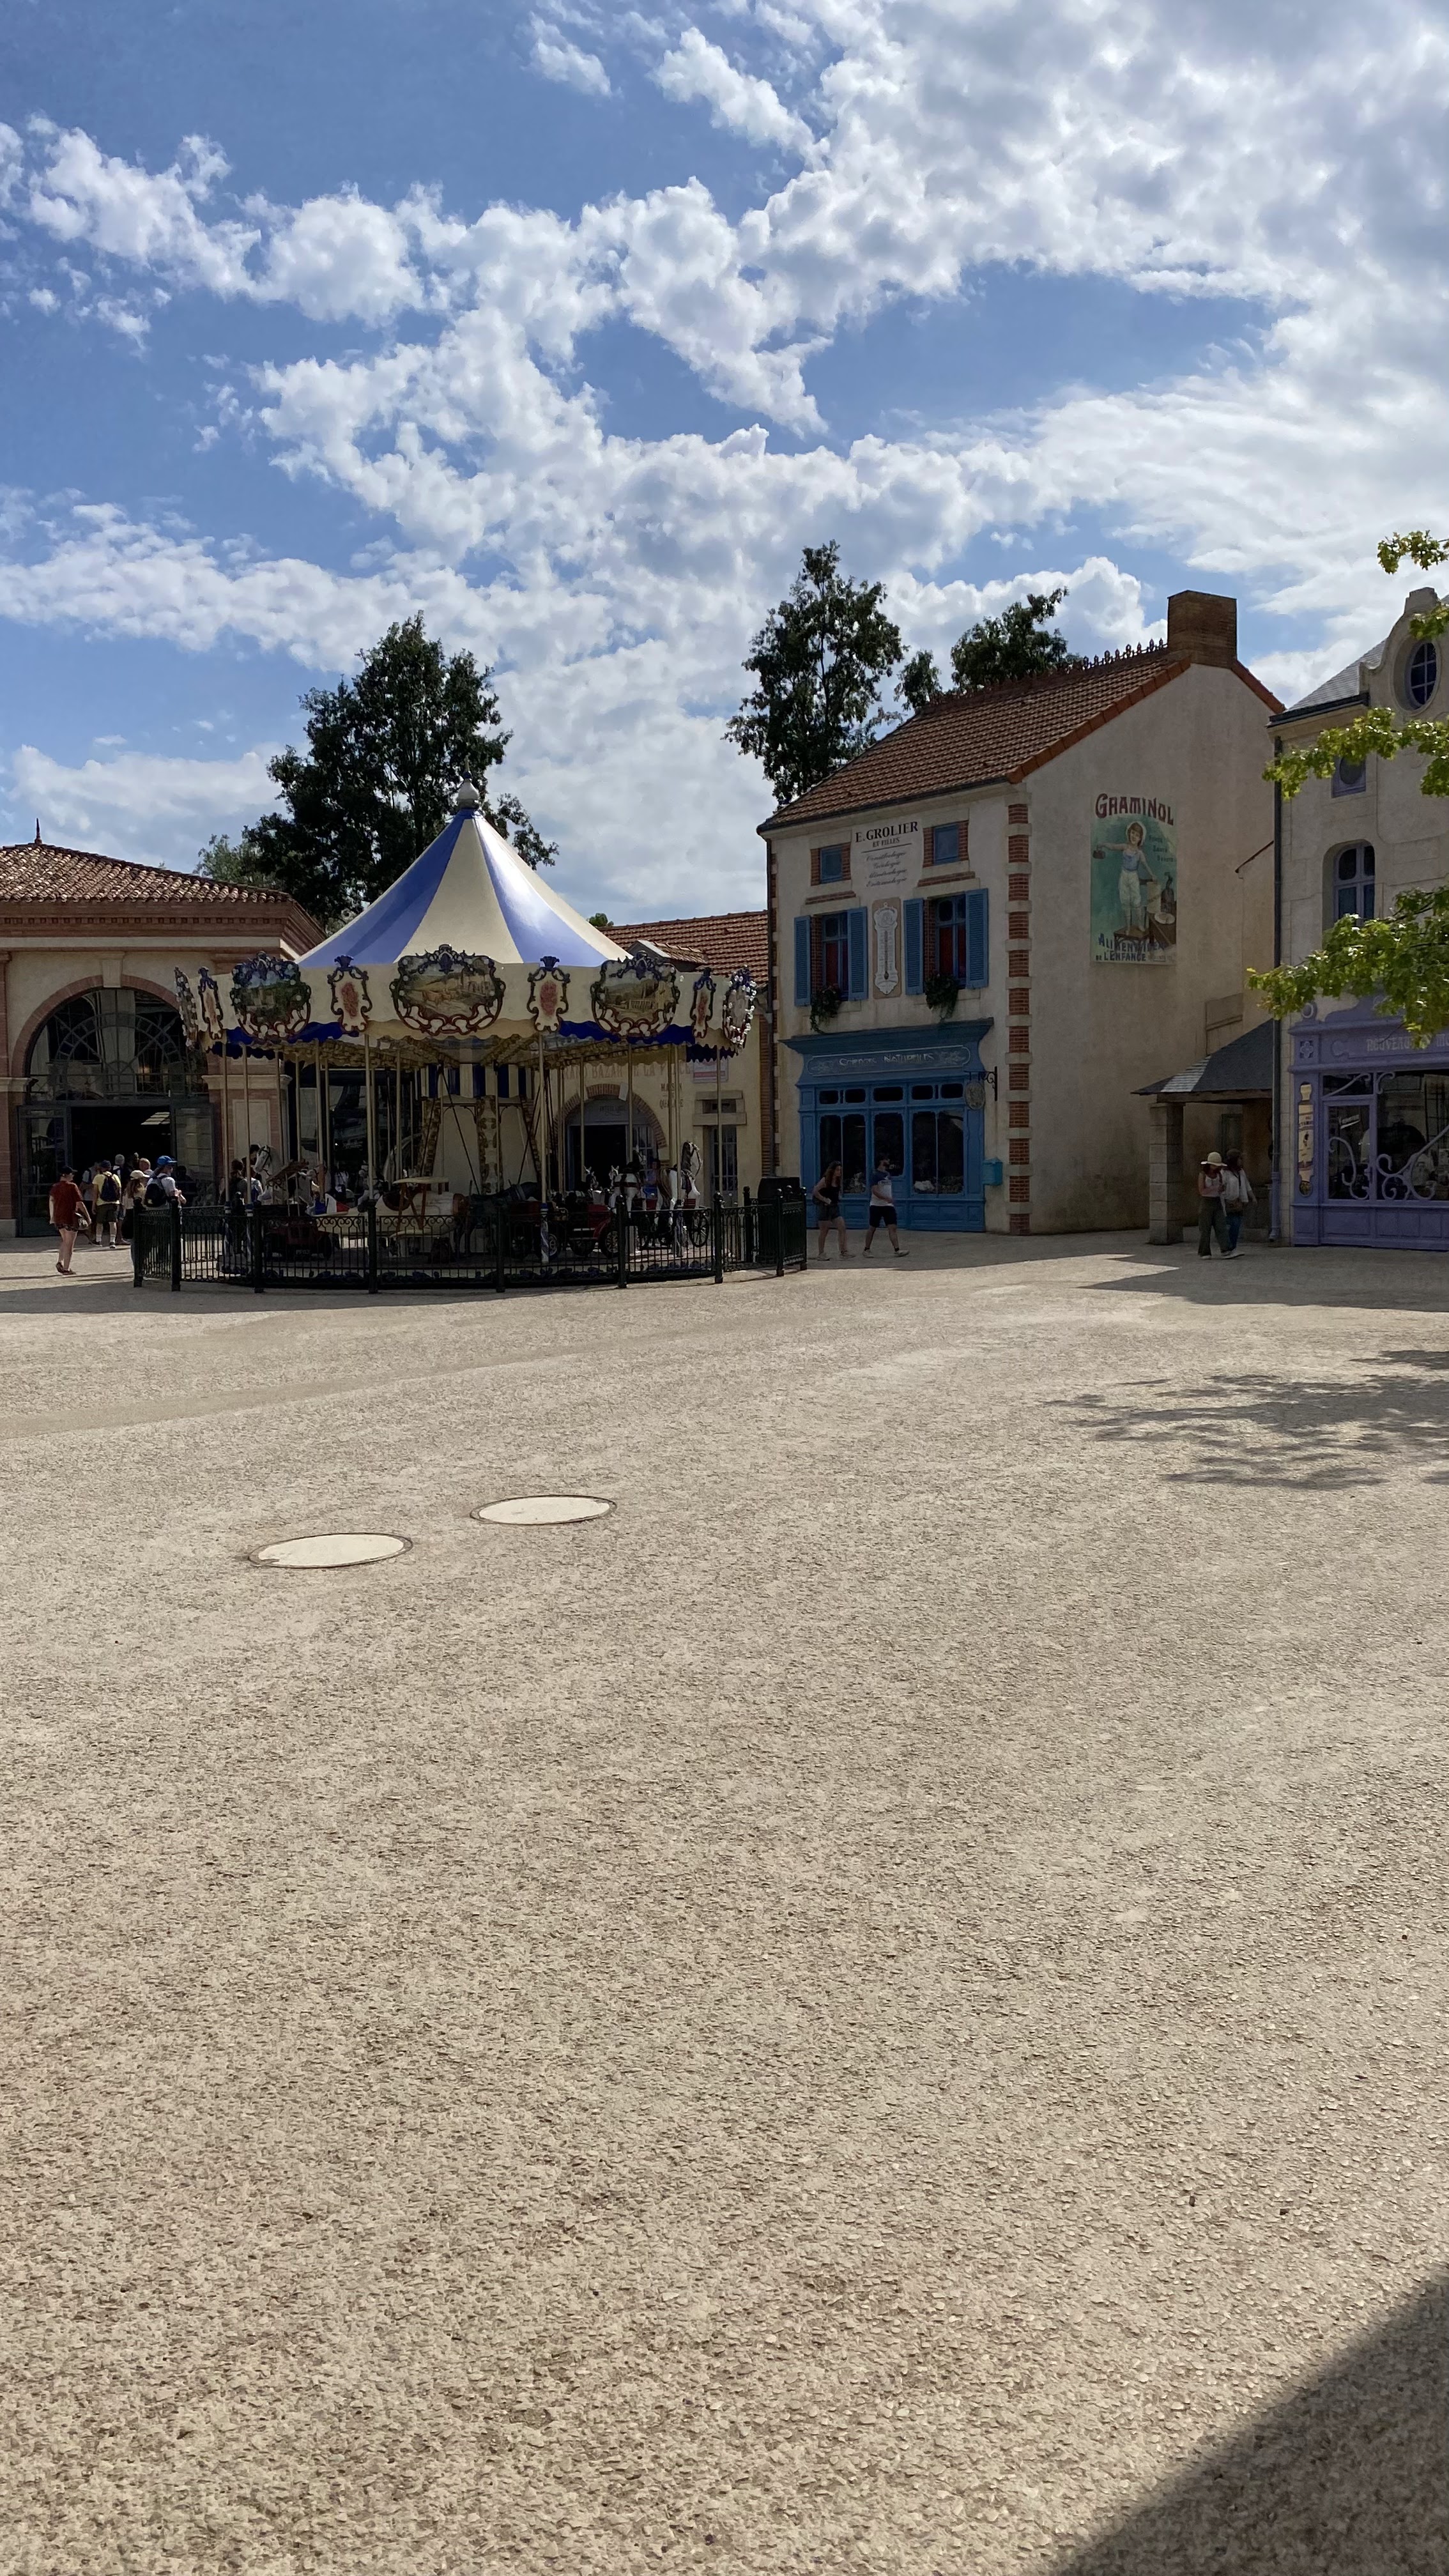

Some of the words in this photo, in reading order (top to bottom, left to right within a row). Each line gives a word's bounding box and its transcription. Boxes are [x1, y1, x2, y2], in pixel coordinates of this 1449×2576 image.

[866, 822, 918, 841] GROLIER
[882, 837, 900, 846] FILLES
[1104, 949, 1147, 962] L'ENFANCE
